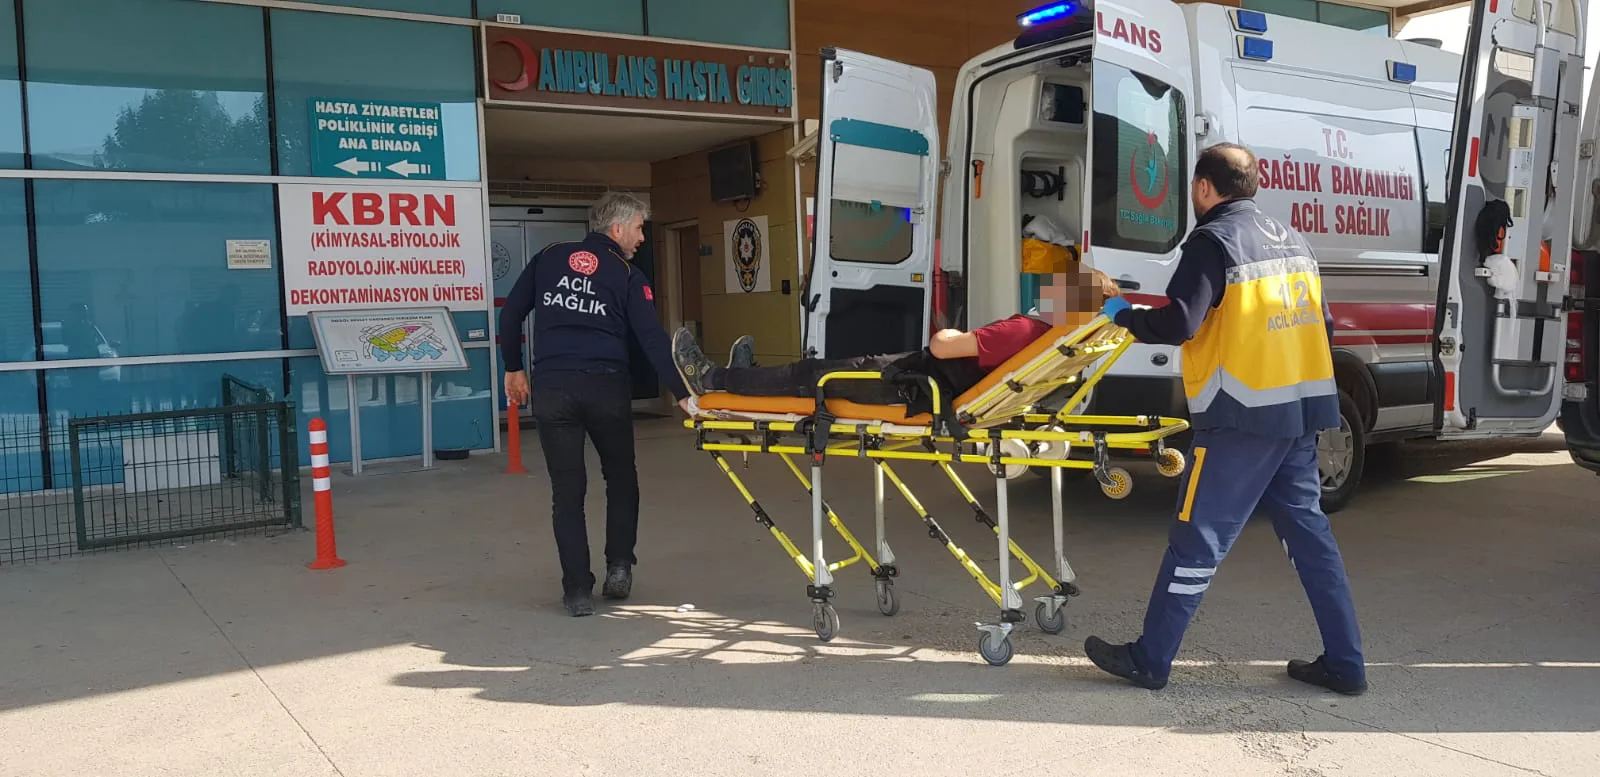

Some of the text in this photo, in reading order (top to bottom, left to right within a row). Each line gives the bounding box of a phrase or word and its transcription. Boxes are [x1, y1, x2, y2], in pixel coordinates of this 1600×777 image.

[1097, 11, 1162, 53] LANS
[538, 48, 657, 97] AMBULANS
[663, 58, 731, 103] HASTA
[315, 101, 439, 120] HASTA ZİYARETLERİ
[318, 118, 438, 140] POLİKLİNİK GİRİŞİ
[338, 137, 421, 153] ANA BİNADA
[1322, 128, 1353, 159] T.C.
[1258, 153, 1414, 201] SAĞLIK BAKANLIĞI
[311, 191, 456, 227] KBRN
[1290, 198, 1390, 236] ACİL SAĞLIK
[310, 229, 460, 251] (KİMYASAL-BİYOLOJİK
[308, 257, 466, 278] RADYOLOJİK-NÜKLEER)
[290, 282, 484, 305] DEKONTAMİNASYON ÜNİTESİ
[556, 275, 596, 295] ACİL
[543, 291, 607, 316] SAĞLIK
